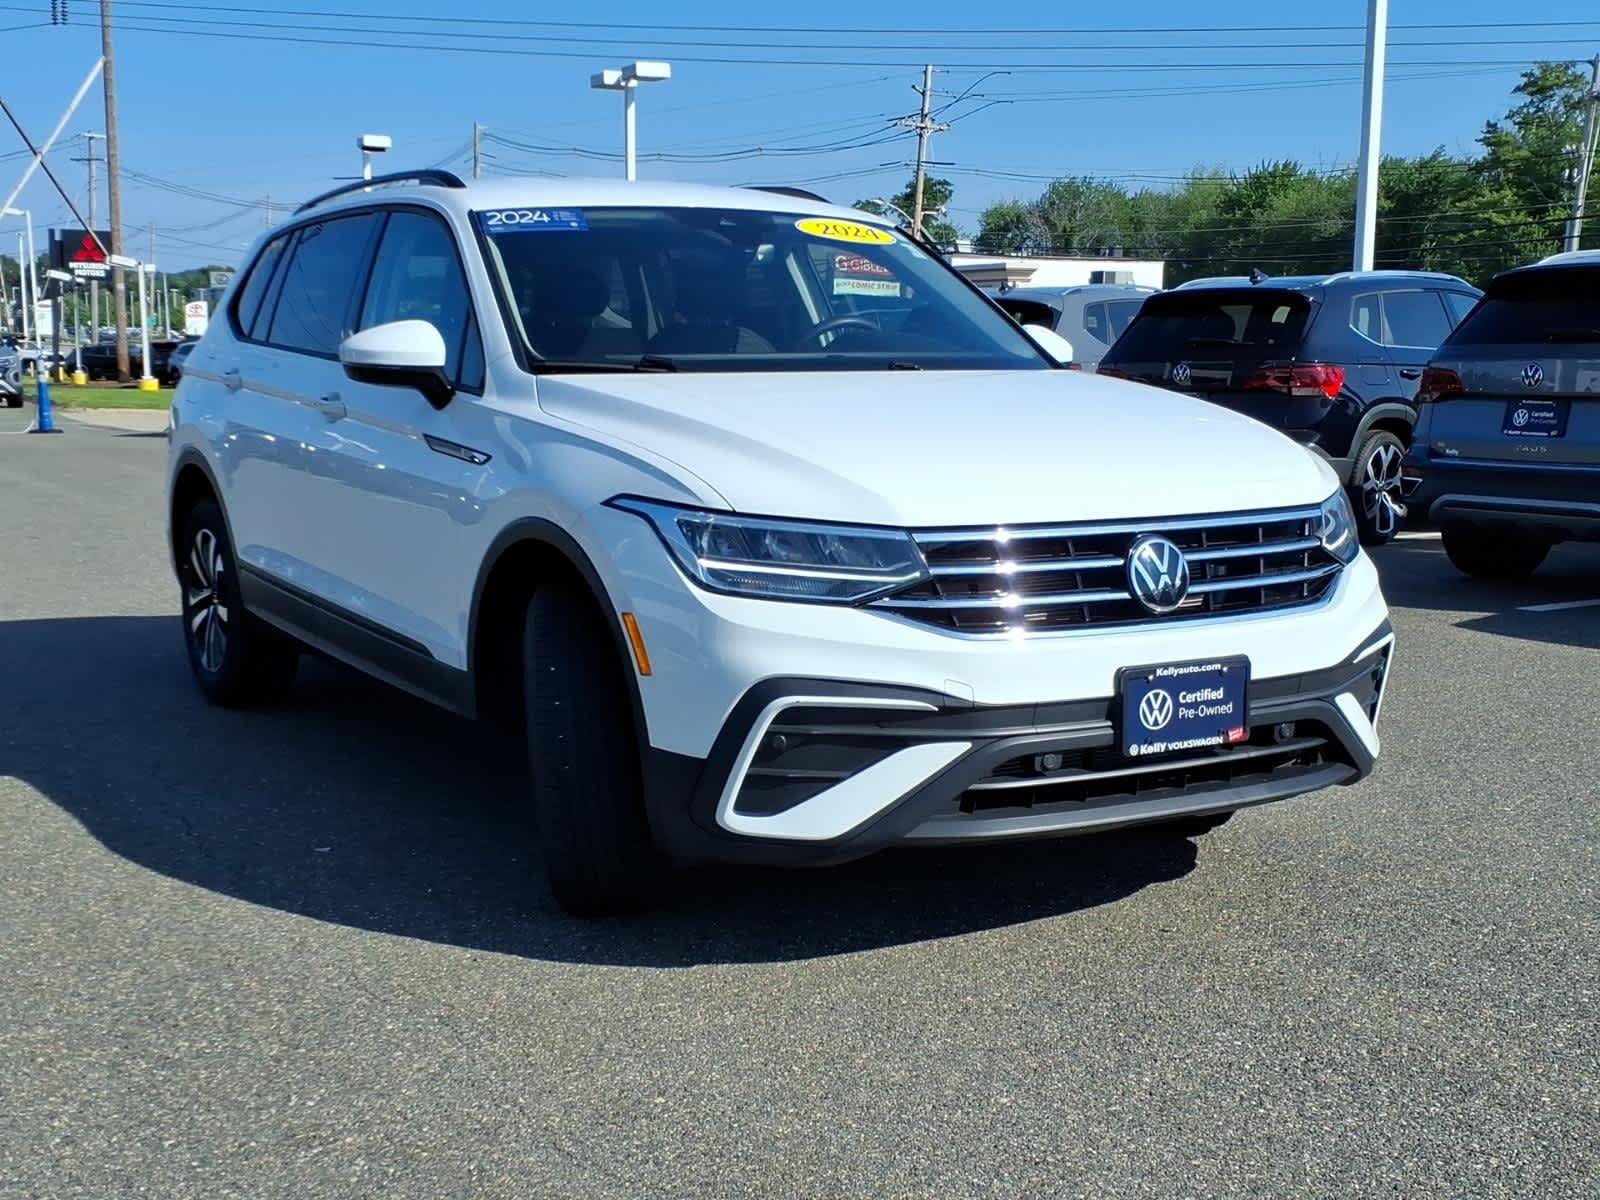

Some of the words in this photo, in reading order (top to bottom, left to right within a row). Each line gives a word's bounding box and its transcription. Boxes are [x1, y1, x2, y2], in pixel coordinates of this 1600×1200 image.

[486, 210, 551, 225] 2024
[816, 223, 879, 238] 2024
[1156, 664, 1221, 677] Kellyauto.com
[1179, 687, 1223, 703] Certified
[1178, 702, 1233, 719] Pre-Owned
[1140, 742, 1166, 755] Kelly
[1168, 736, 1223, 749] VOLKSWAGEN
